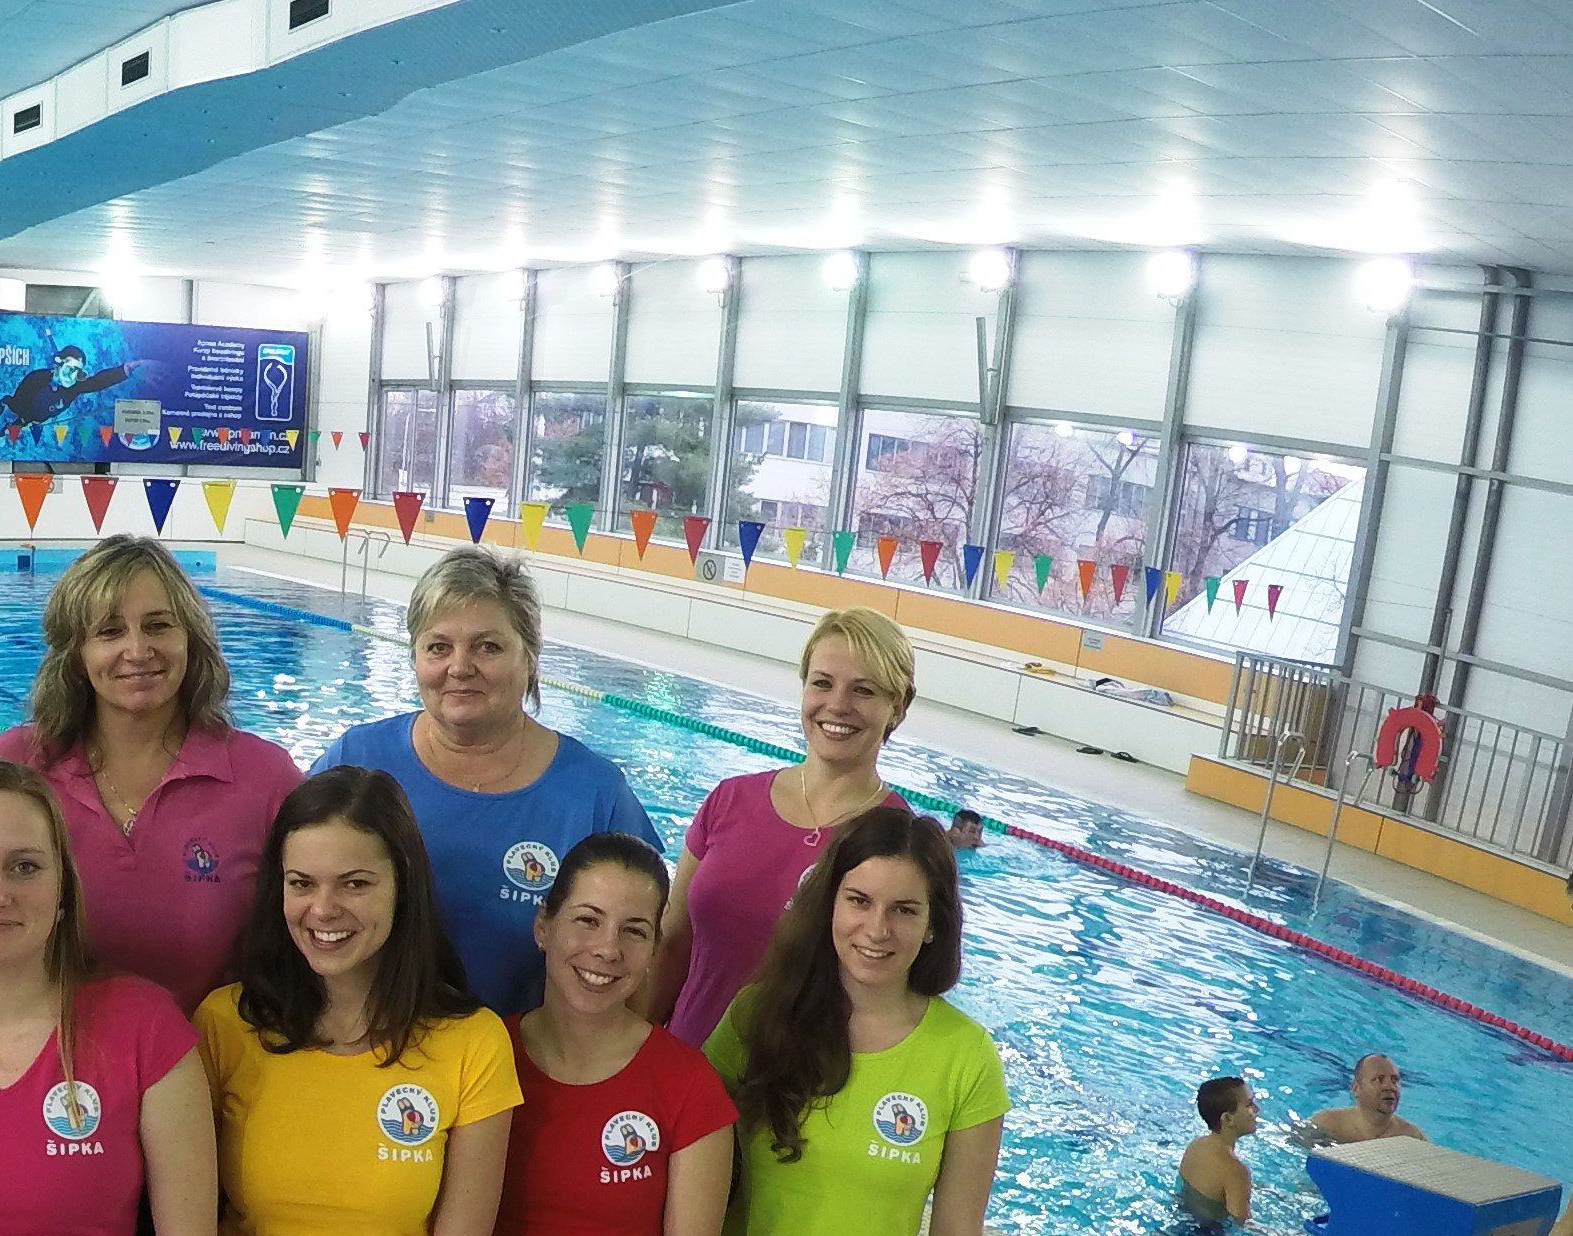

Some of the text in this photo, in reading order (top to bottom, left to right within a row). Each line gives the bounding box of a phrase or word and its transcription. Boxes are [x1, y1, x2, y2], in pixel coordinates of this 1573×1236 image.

[499, 884, 544, 906] ŠIPK
[46, 1139, 104, 1156] ŠIPKA
[377, 1142, 434, 1163] ŠIPKA
[867, 1139, 921, 1164] ŠIPKA
[599, 1165, 653, 1184] ŠIPKA
